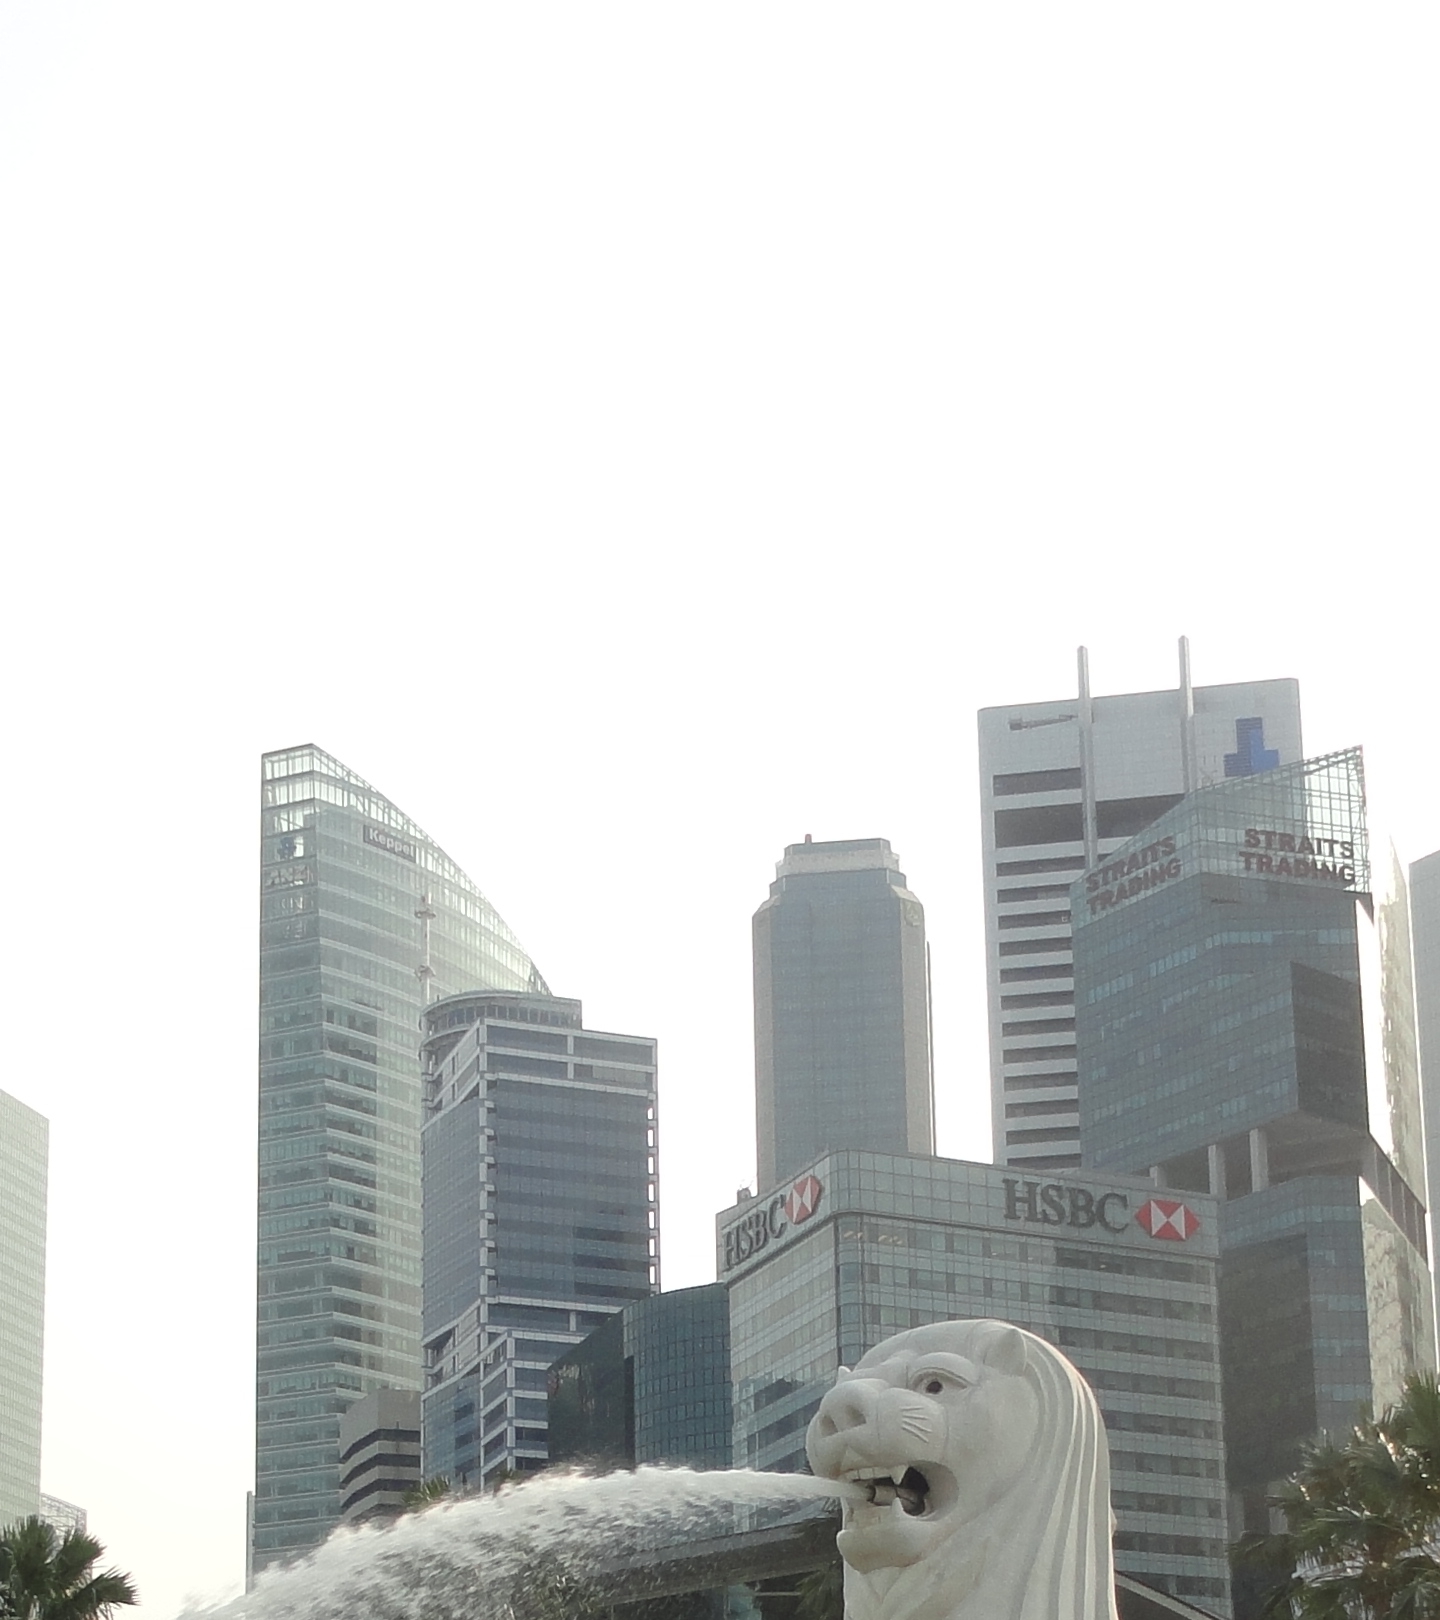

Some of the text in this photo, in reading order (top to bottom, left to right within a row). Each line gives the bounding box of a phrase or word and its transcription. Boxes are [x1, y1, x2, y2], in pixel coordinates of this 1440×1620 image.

[368, 827, 414, 858] Keppel
[1086, 835, 1177, 893] STRAITS
[1239, 850, 1356, 883] TRADING
[1245, 828, 1355, 859] STRAITS
[1086, 857, 1183, 916] TRADING
[722, 1194, 787, 1273] HSBC
[1002, 1178, 1129, 1234] HSBC
